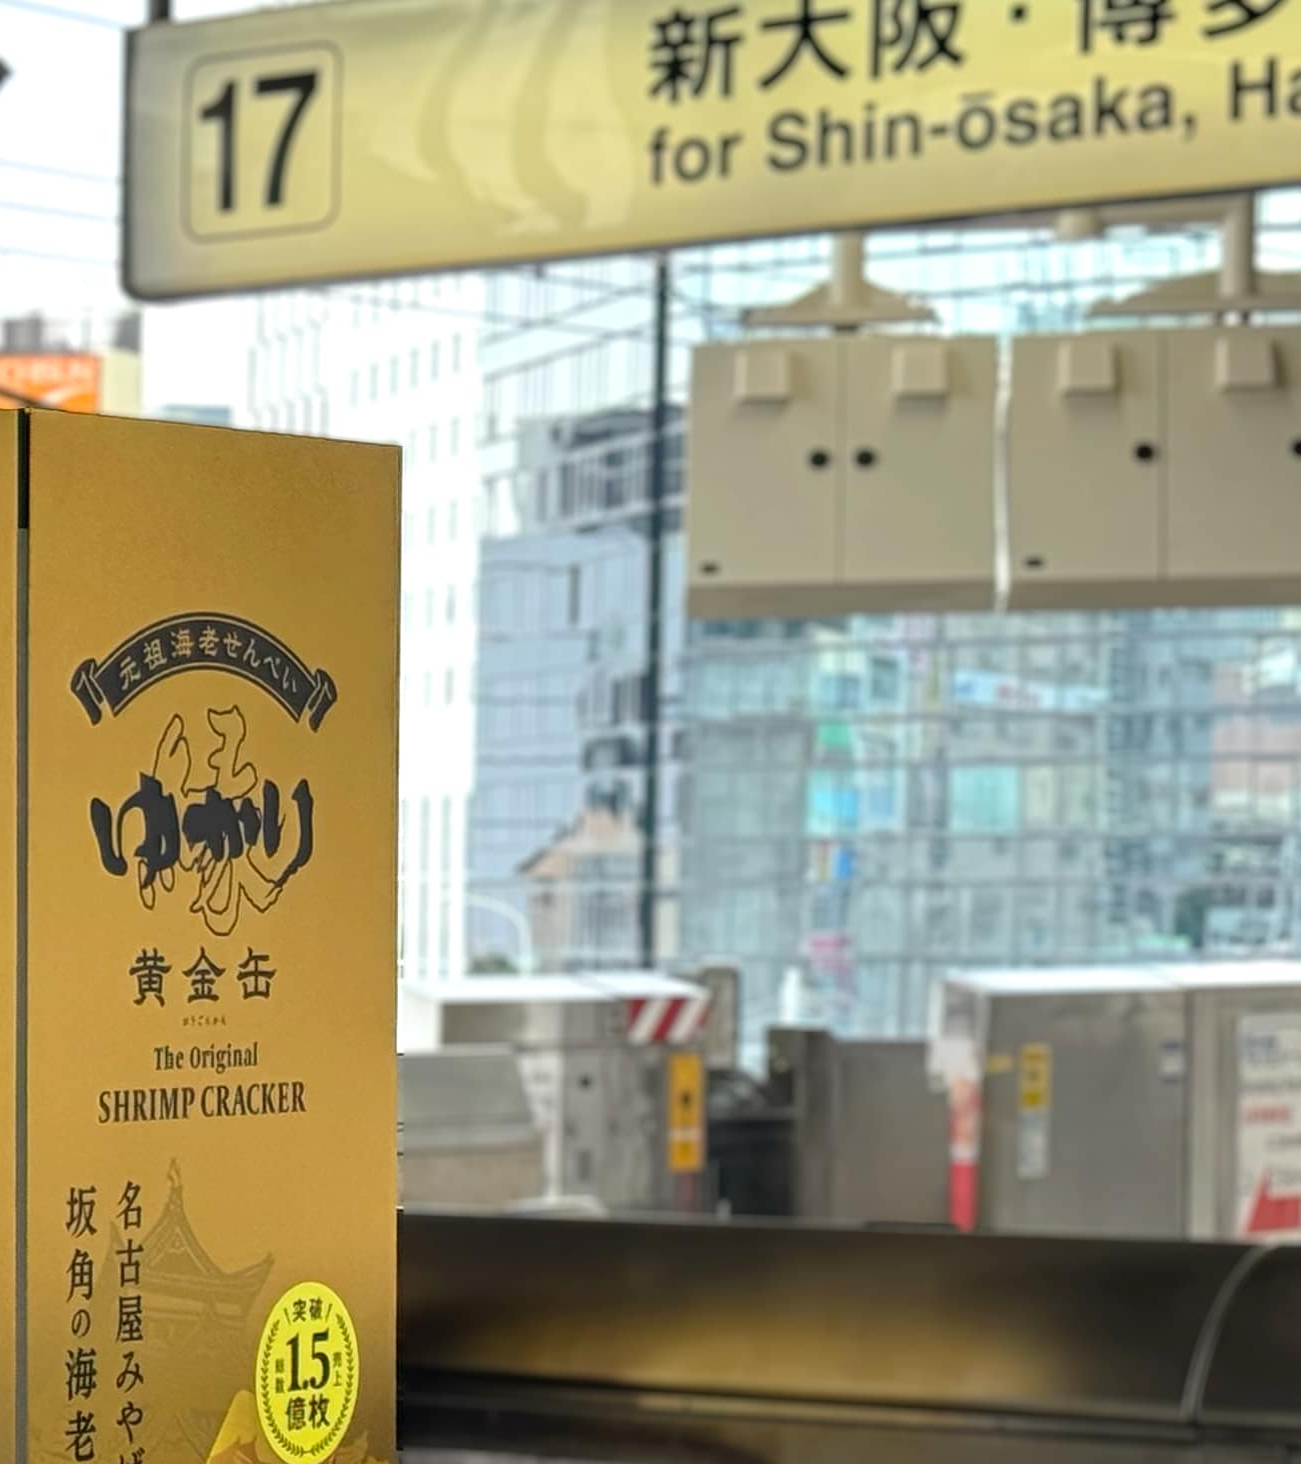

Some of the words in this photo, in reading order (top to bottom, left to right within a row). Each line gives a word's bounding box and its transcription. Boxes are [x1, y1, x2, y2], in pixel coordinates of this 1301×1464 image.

[200, 71, 319, 211] 17
[648, 126, 742, 186] for
[764, 76, 1198, 172] Shin-ōsaka,
[117, 625, 299, 694] 元祖海老せんべい
[129, 946, 278, 1008] 黄金缶
[154, 1046, 185, 1072] The
[189, 1041, 259, 1075] Original
[99, 1087, 196, 1125] SHRIMP
[201, 1080, 307, 1120] CRACKER
[286, 1328, 331, 1392] 1.5
[285, 1395, 331, 1432] 億枚
